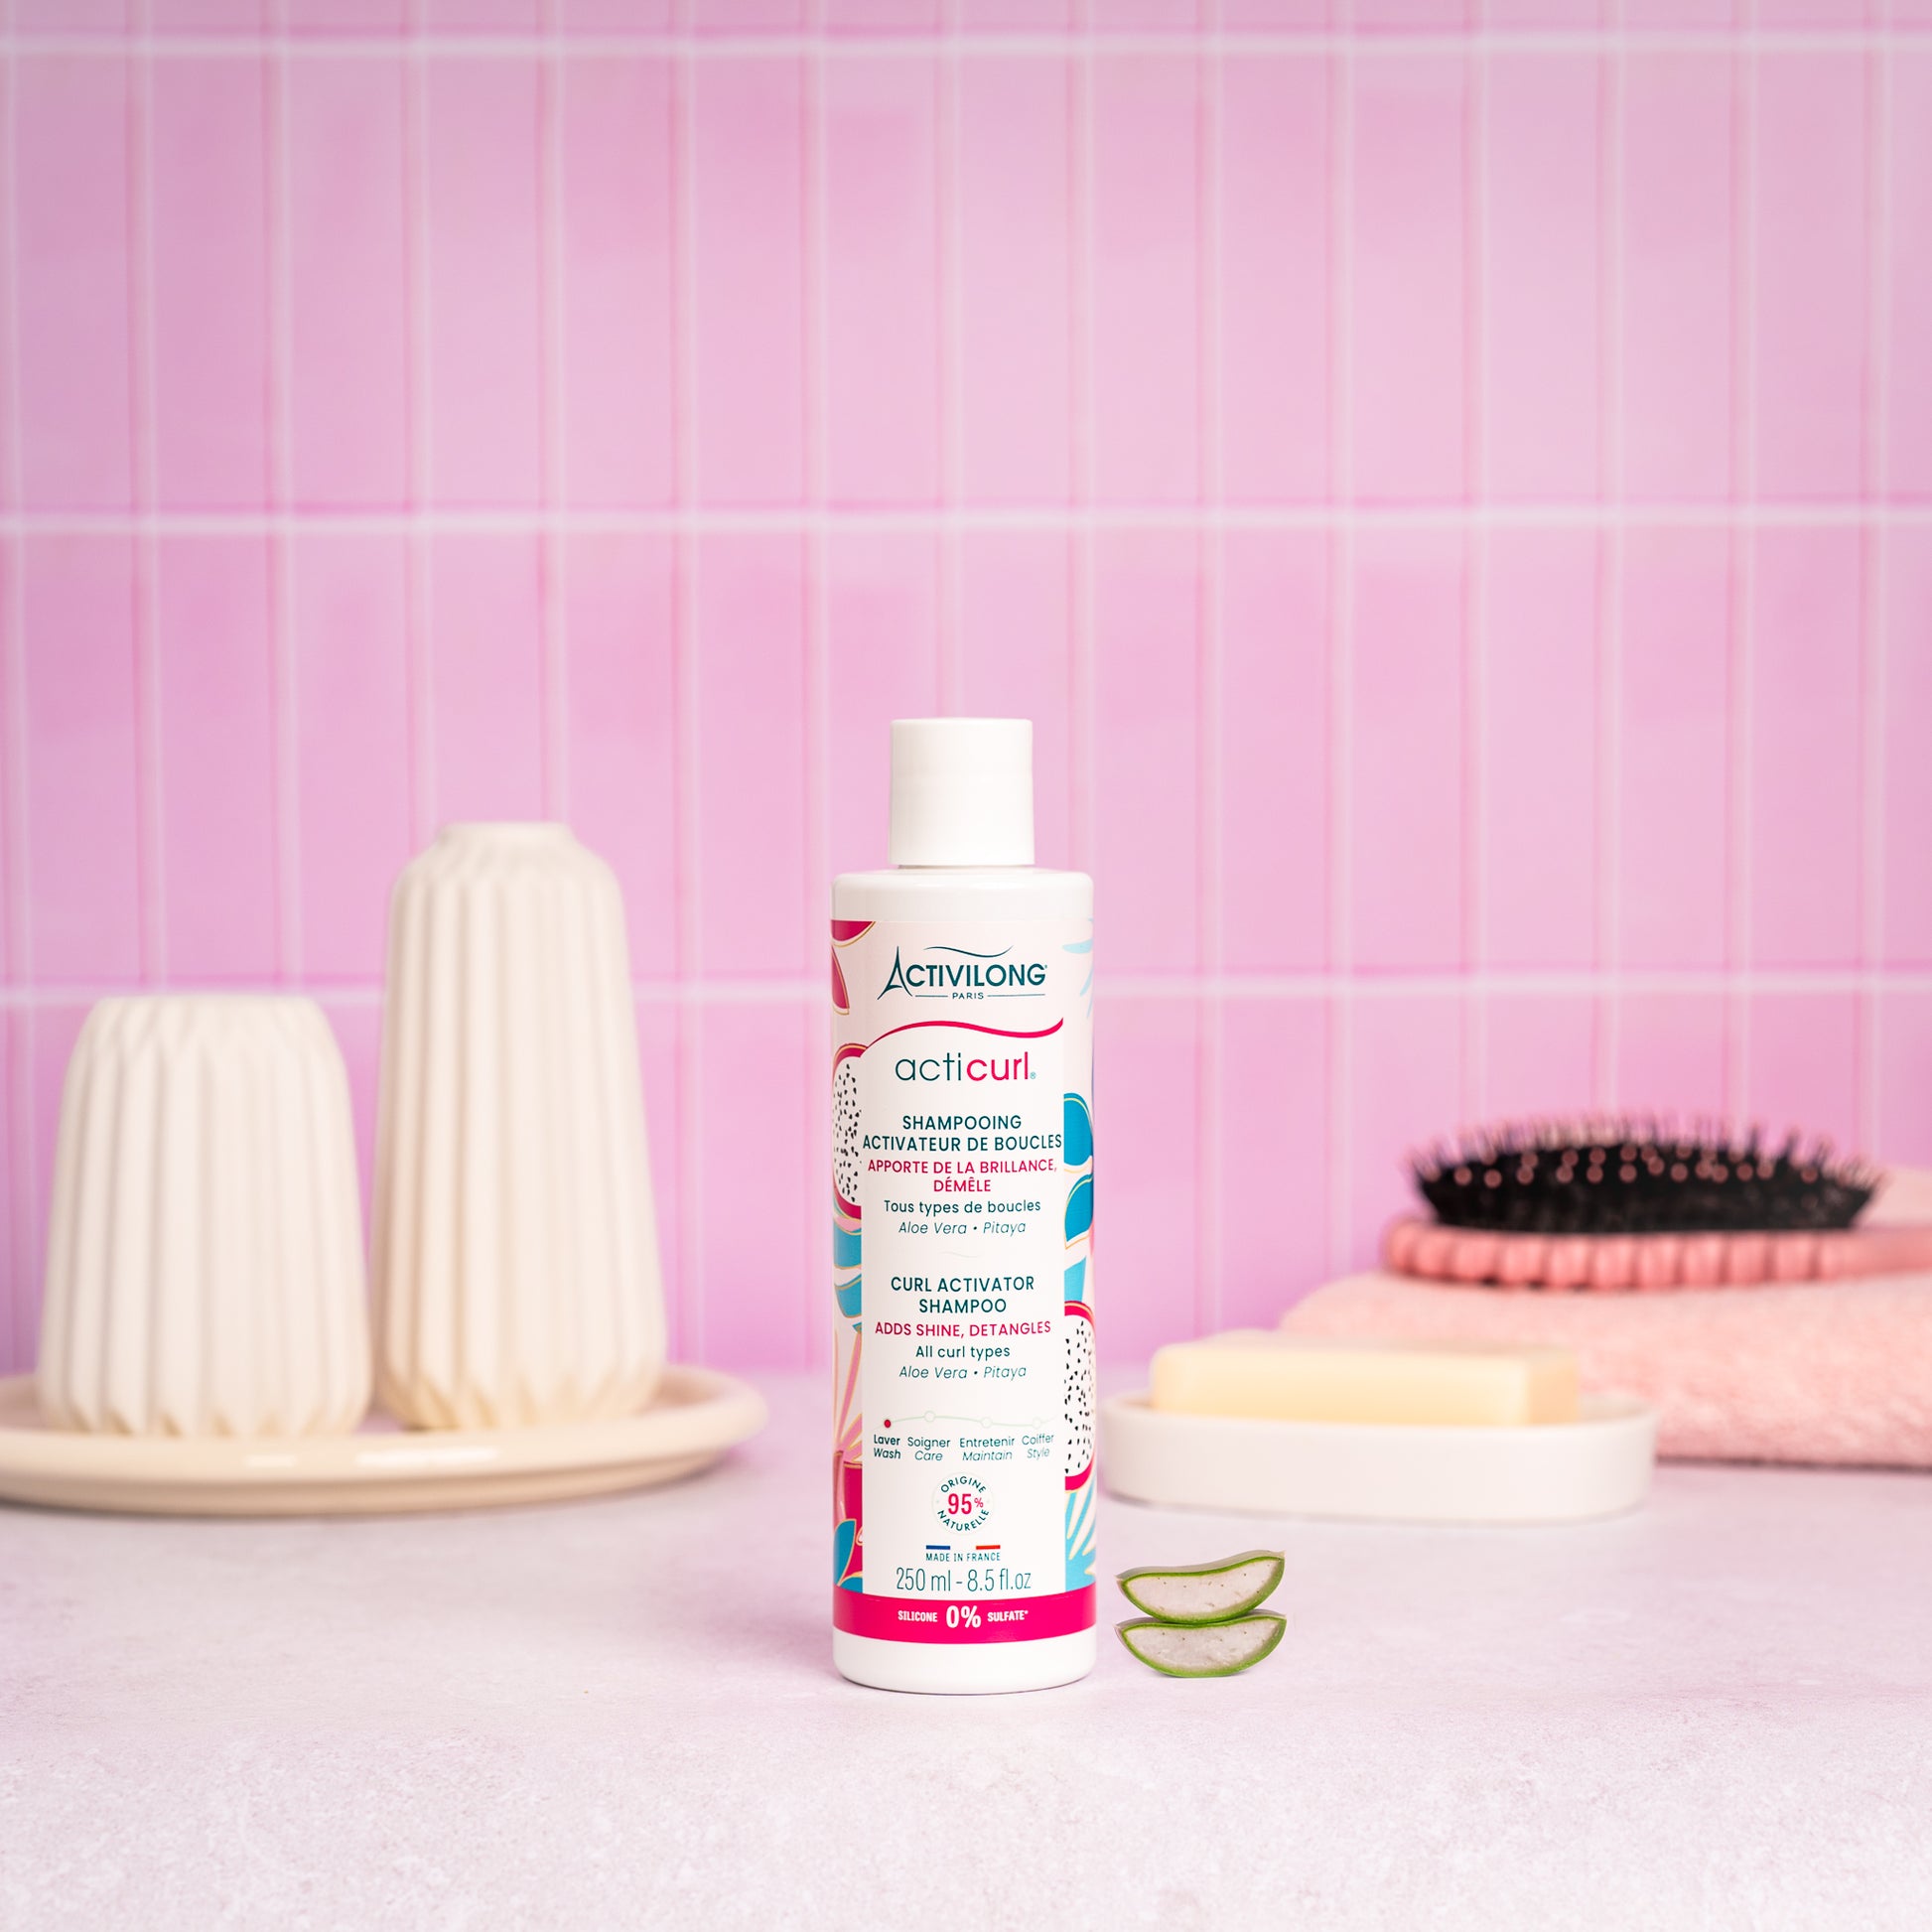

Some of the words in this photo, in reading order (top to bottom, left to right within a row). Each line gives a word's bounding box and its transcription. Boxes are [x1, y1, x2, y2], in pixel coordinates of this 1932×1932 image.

[877, 946, 1046, 1001] ACTIVILONG
[902, 1115, 1022, 1130] SHAMPOOING
[863, 1135, 961, 1152] ACTIVATEUR
[967, 1137, 988, 1152] DE
[994, 1134, 1062, 1151] BOUCLES
[868, 1159, 928, 1174] APPORTE
[933, 1162, 952, 1173] DE
[957, 1162, 975, 1173] LA
[980, 1159, 1057, 1173] BRILLANCE,
[933, 1176, 992, 1192] DÉMÊLE
[884, 1199, 914, 1212] Tous
[919, 1201, 959, 1217] types
[965, 1199, 982, 1213] de
[988, 1199, 1041, 1213] boucles
[898, 1221, 928, 1234] Aloe
[934, 1222, 967, 1234] Vera
[983, 1220, 1027, 1237] Pitaya
[891, 1277, 932, 1292] CURL
[937, 1276, 1035, 1292] ACTIVATOR
[919, 1299, 1007, 1313] SHAMPOO
[875, 1321, 911, 1336] ADDS
[916, 1324, 964, 1338] SHINE,
[970, 1320, 1051, 1337] DETANGLES
[915, 1345, 933, 1358] All
[938, 1346, 965, 1358] curl
[971, 1346, 1011, 1361] types
[898, 1366, 929, 1379] Aloe
[934, 1367, 968, 1379] Vera
[984, 1366, 1027, 1381] Pitaya
[874, 1435, 901, 1446] Laver
[907, 1437, 951, 1450] Soigner
[960, 1438, 1015, 1449] Entretenir
[1022, 1434, 1054, 1446] Coiffer
[874, 1448, 901, 1459] Wash
[914, 1449, 943, 1461] Care
[963, 1450, 1013, 1461] Maintain
[1027, 1447, 1050, 1460] Style
[940, 1475, 987, 1493] ORIGINE
[937, 1509, 990, 1532] NATURELLE
[925, 1553, 950, 1562] MADE
[954, 1553, 963, 1562] IN
[966, 1552, 1001, 1562] FRANCE
[896, 1567, 926, 1590] 250
[931, 1569, 951, 1591] ml
[967, 1569, 995, 1591] 8.5
[999, 1568, 1032, 1590] fl.oz
[897, 1609, 938, 1622] SILICONE
[945, 1604, 982, 1628] 0%
